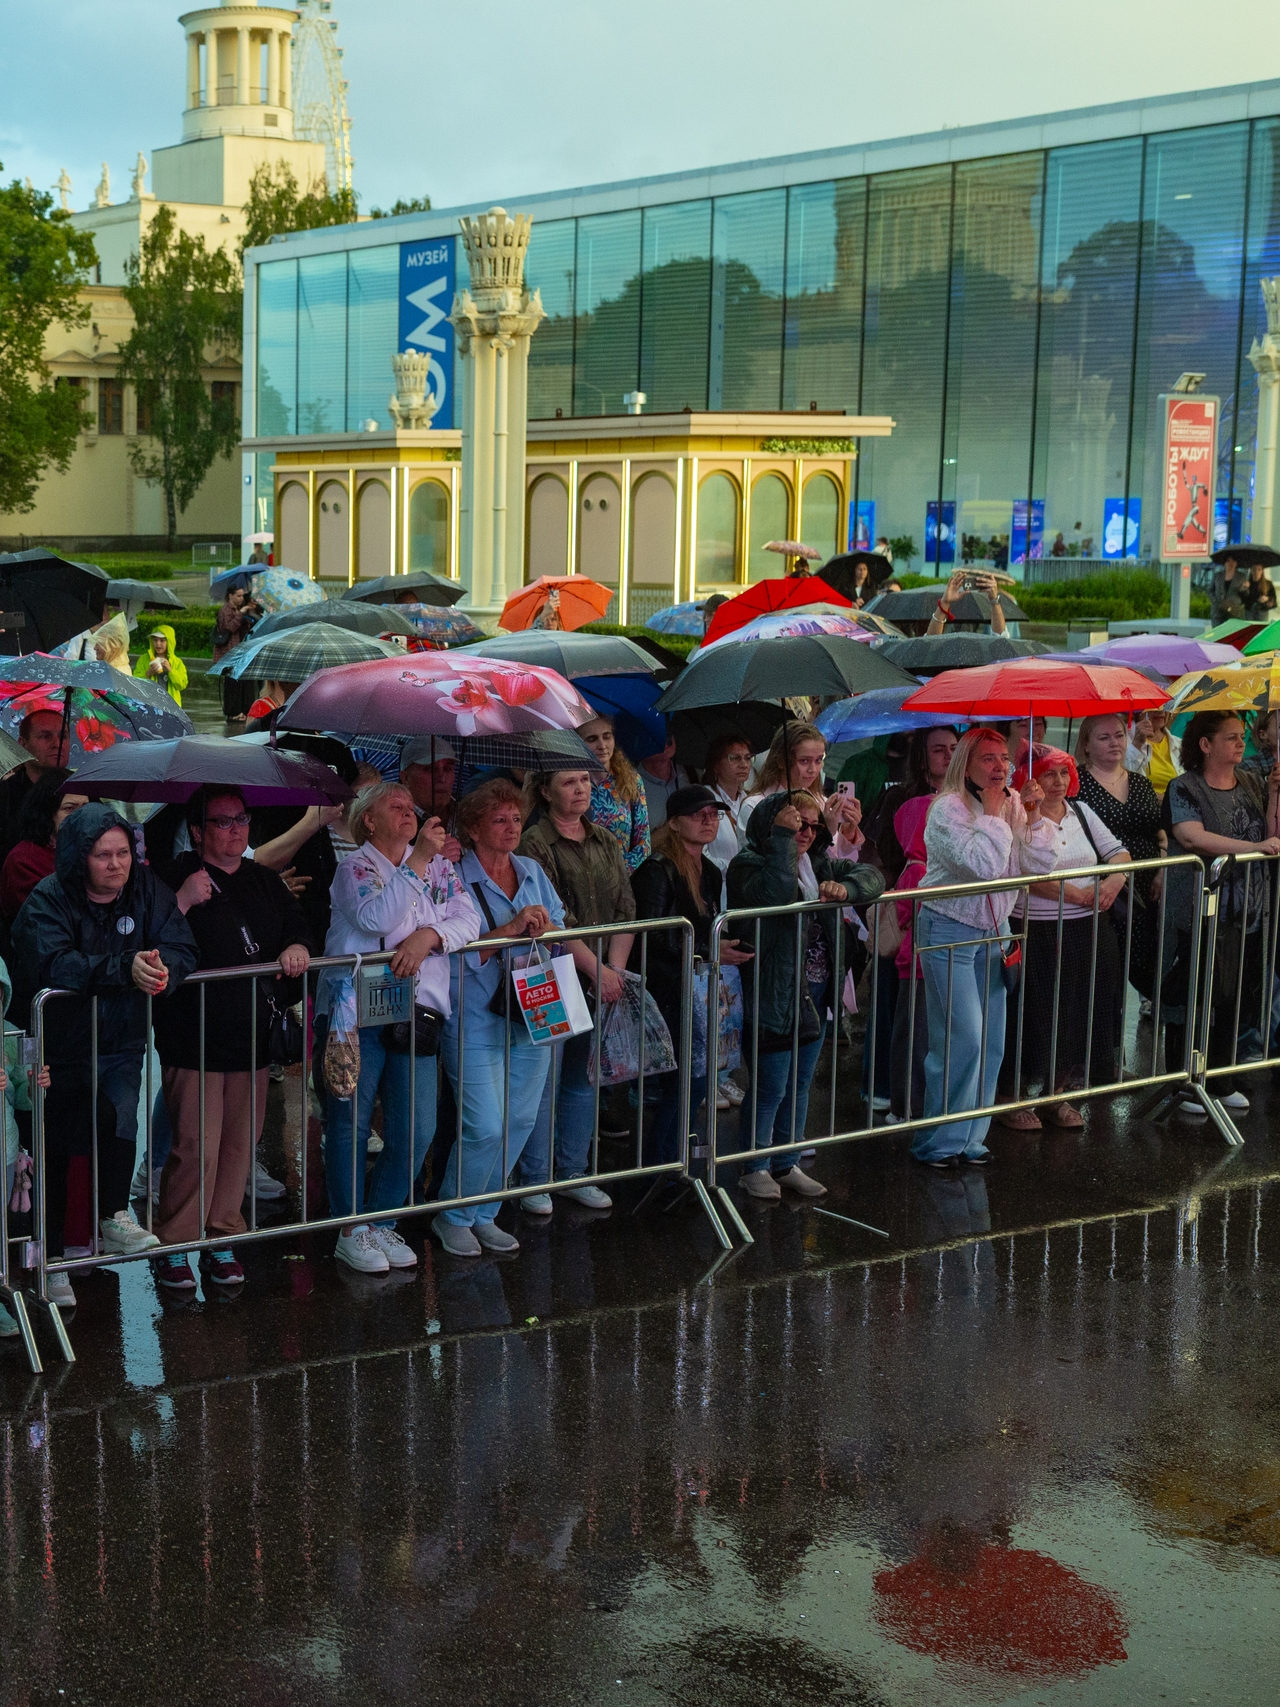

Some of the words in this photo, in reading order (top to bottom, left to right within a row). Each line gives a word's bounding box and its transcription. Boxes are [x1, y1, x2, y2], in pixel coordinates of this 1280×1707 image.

[406, 244, 449, 268] МУЗЕЙ
[1179, 446, 1210, 462] ЖДУТ
[1167, 447, 1179, 526] РОБОТЫ
[526, 985, 553, 1000] ЛЕТО
[531, 993, 554, 1003] МОСКВЕ
[369, 1004, 403, 1017] ВДНХ
